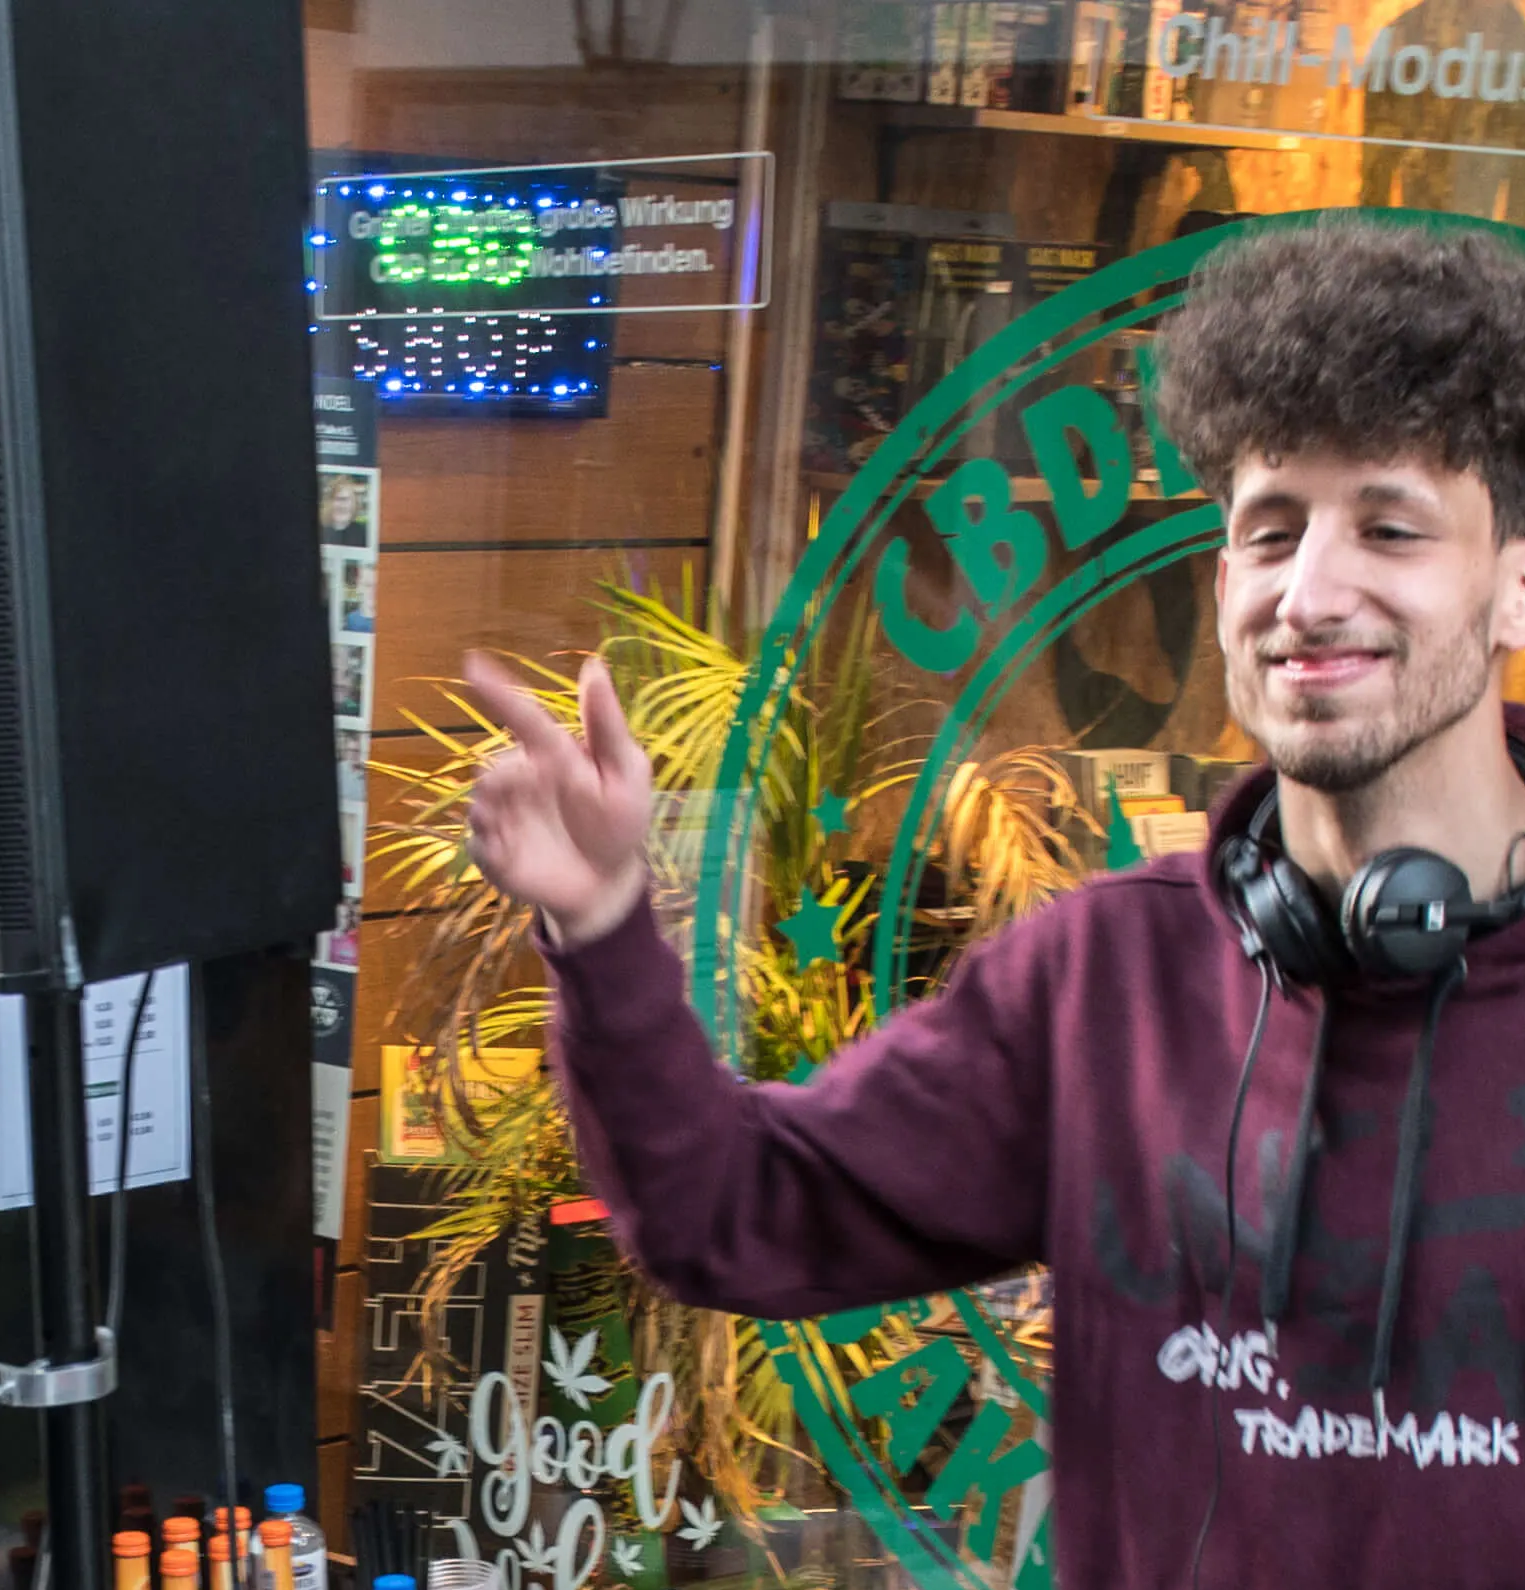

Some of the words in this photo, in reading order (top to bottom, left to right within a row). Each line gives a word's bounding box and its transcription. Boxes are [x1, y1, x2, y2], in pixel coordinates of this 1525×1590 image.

[619, 195, 734, 231] Wirkung
[348, 306, 557, 380] SHOP
[513, 1302, 537, 1358] SLIM
[472, 1371, 681, 1537] good
[1234, 1404, 1521, 1469] TRADEMARK
